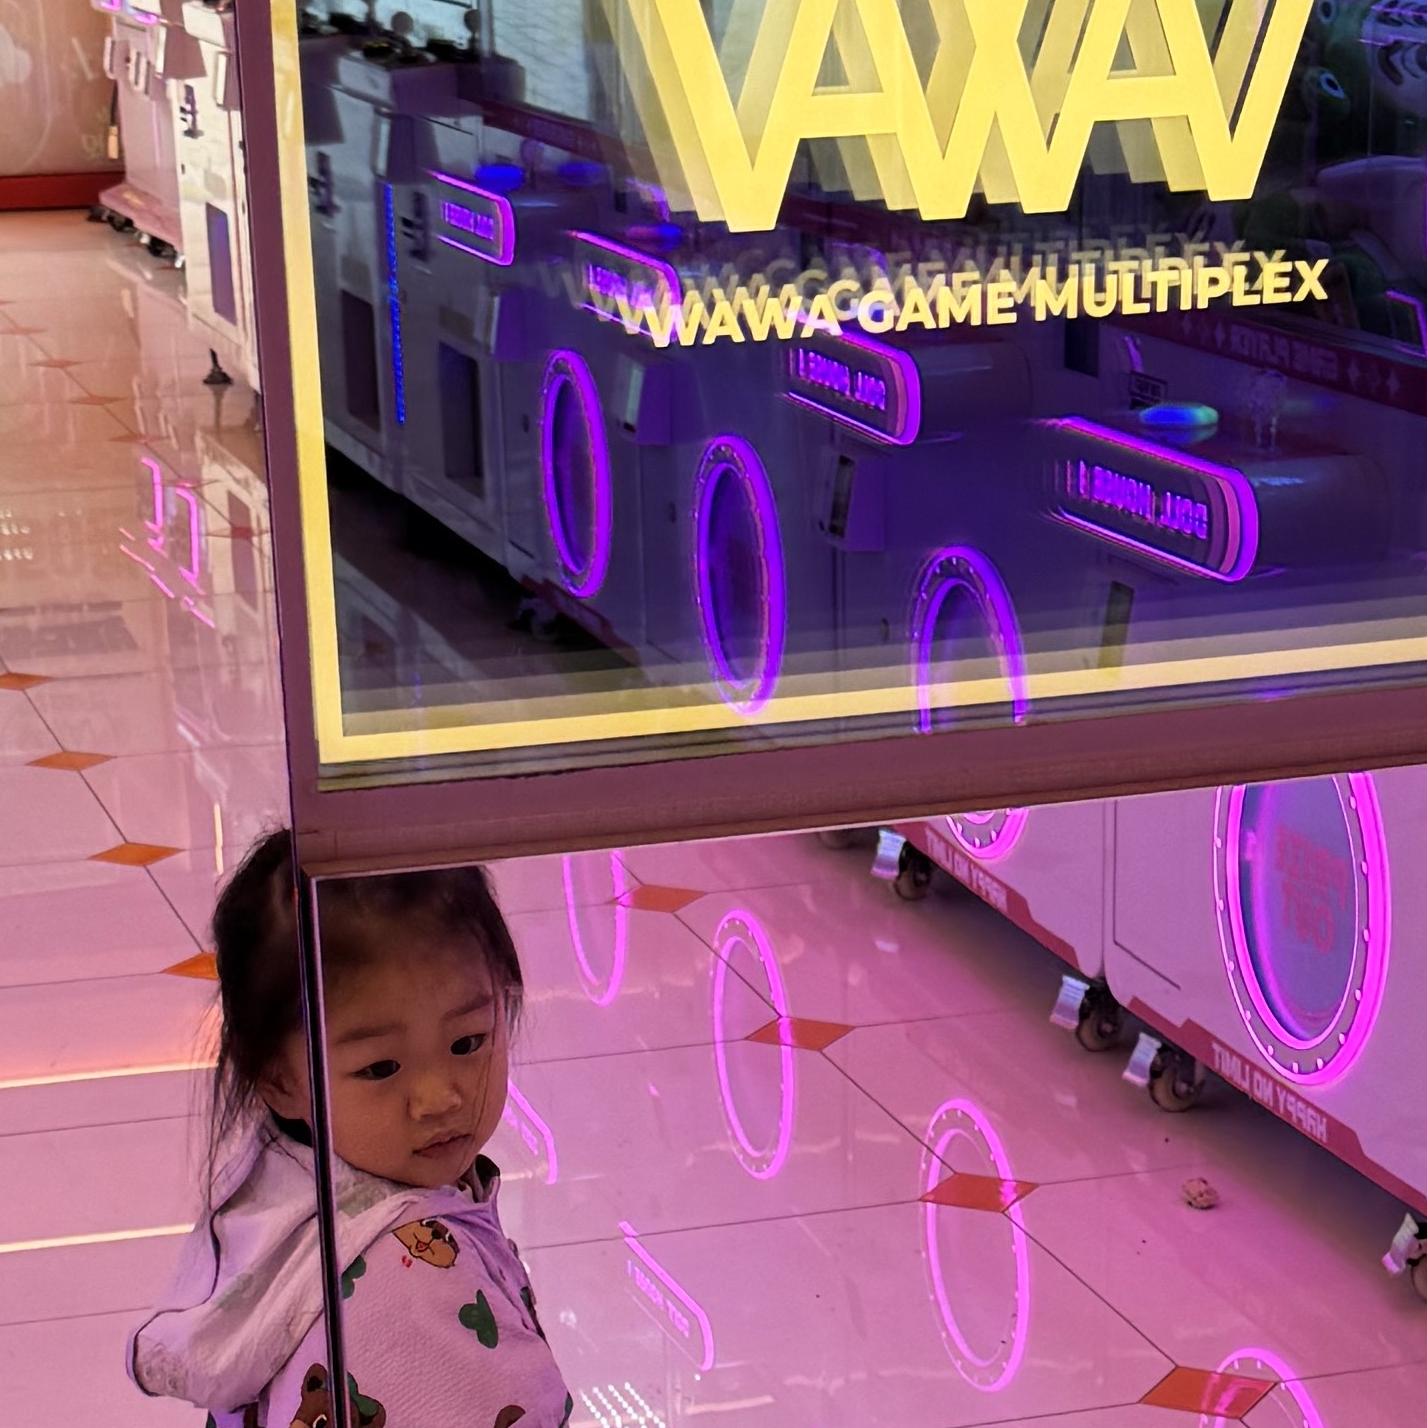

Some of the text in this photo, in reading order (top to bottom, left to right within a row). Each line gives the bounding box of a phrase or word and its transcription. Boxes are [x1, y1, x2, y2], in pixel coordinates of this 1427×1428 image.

[645, 259, 1329, 348] WAWA GAME MULTIPLEX
